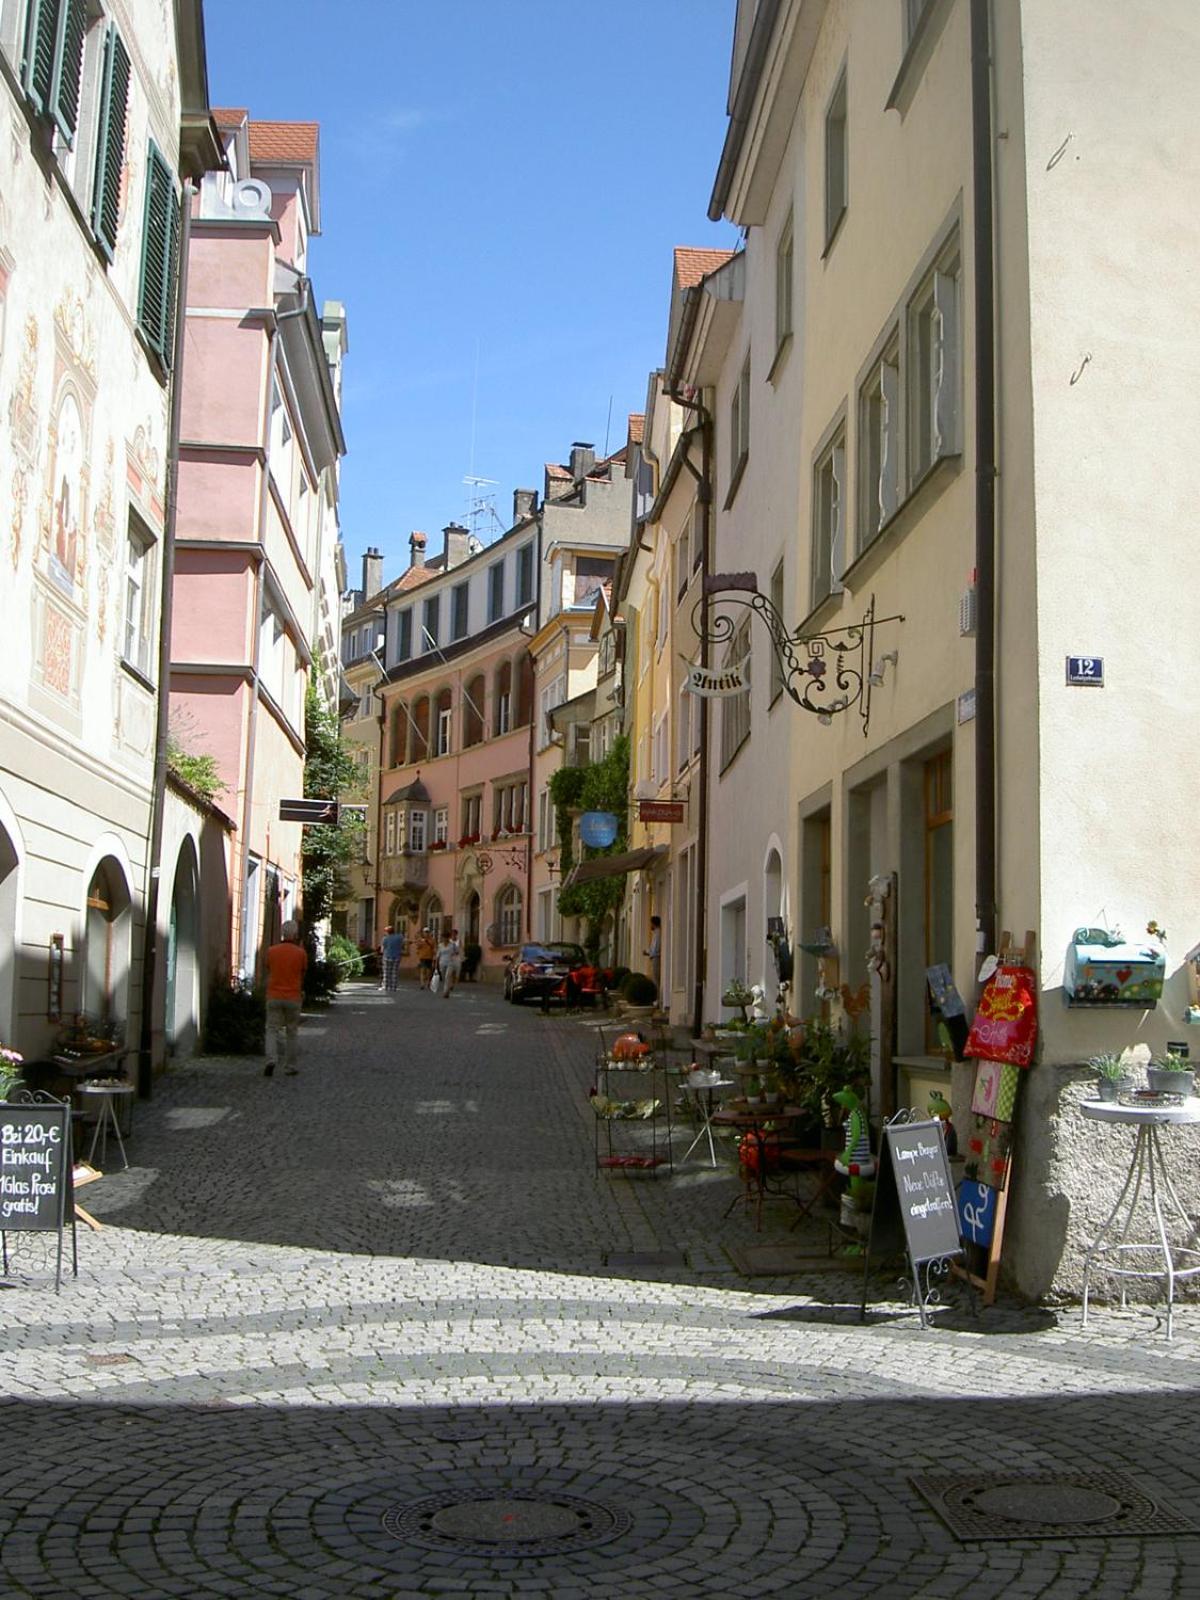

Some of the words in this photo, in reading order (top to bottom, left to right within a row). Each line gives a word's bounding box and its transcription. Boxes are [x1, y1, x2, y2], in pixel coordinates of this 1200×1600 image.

[1077, 659, 1095, 675] 12
[693, 672, 742, 690] Antik
[1, 1124, 22, 1145] Bei
[2, 1148, 53, 1173] Einkauf
[903, 1174, 922, 1193] Neue
[2, 1196, 39, 1217] gratis!
